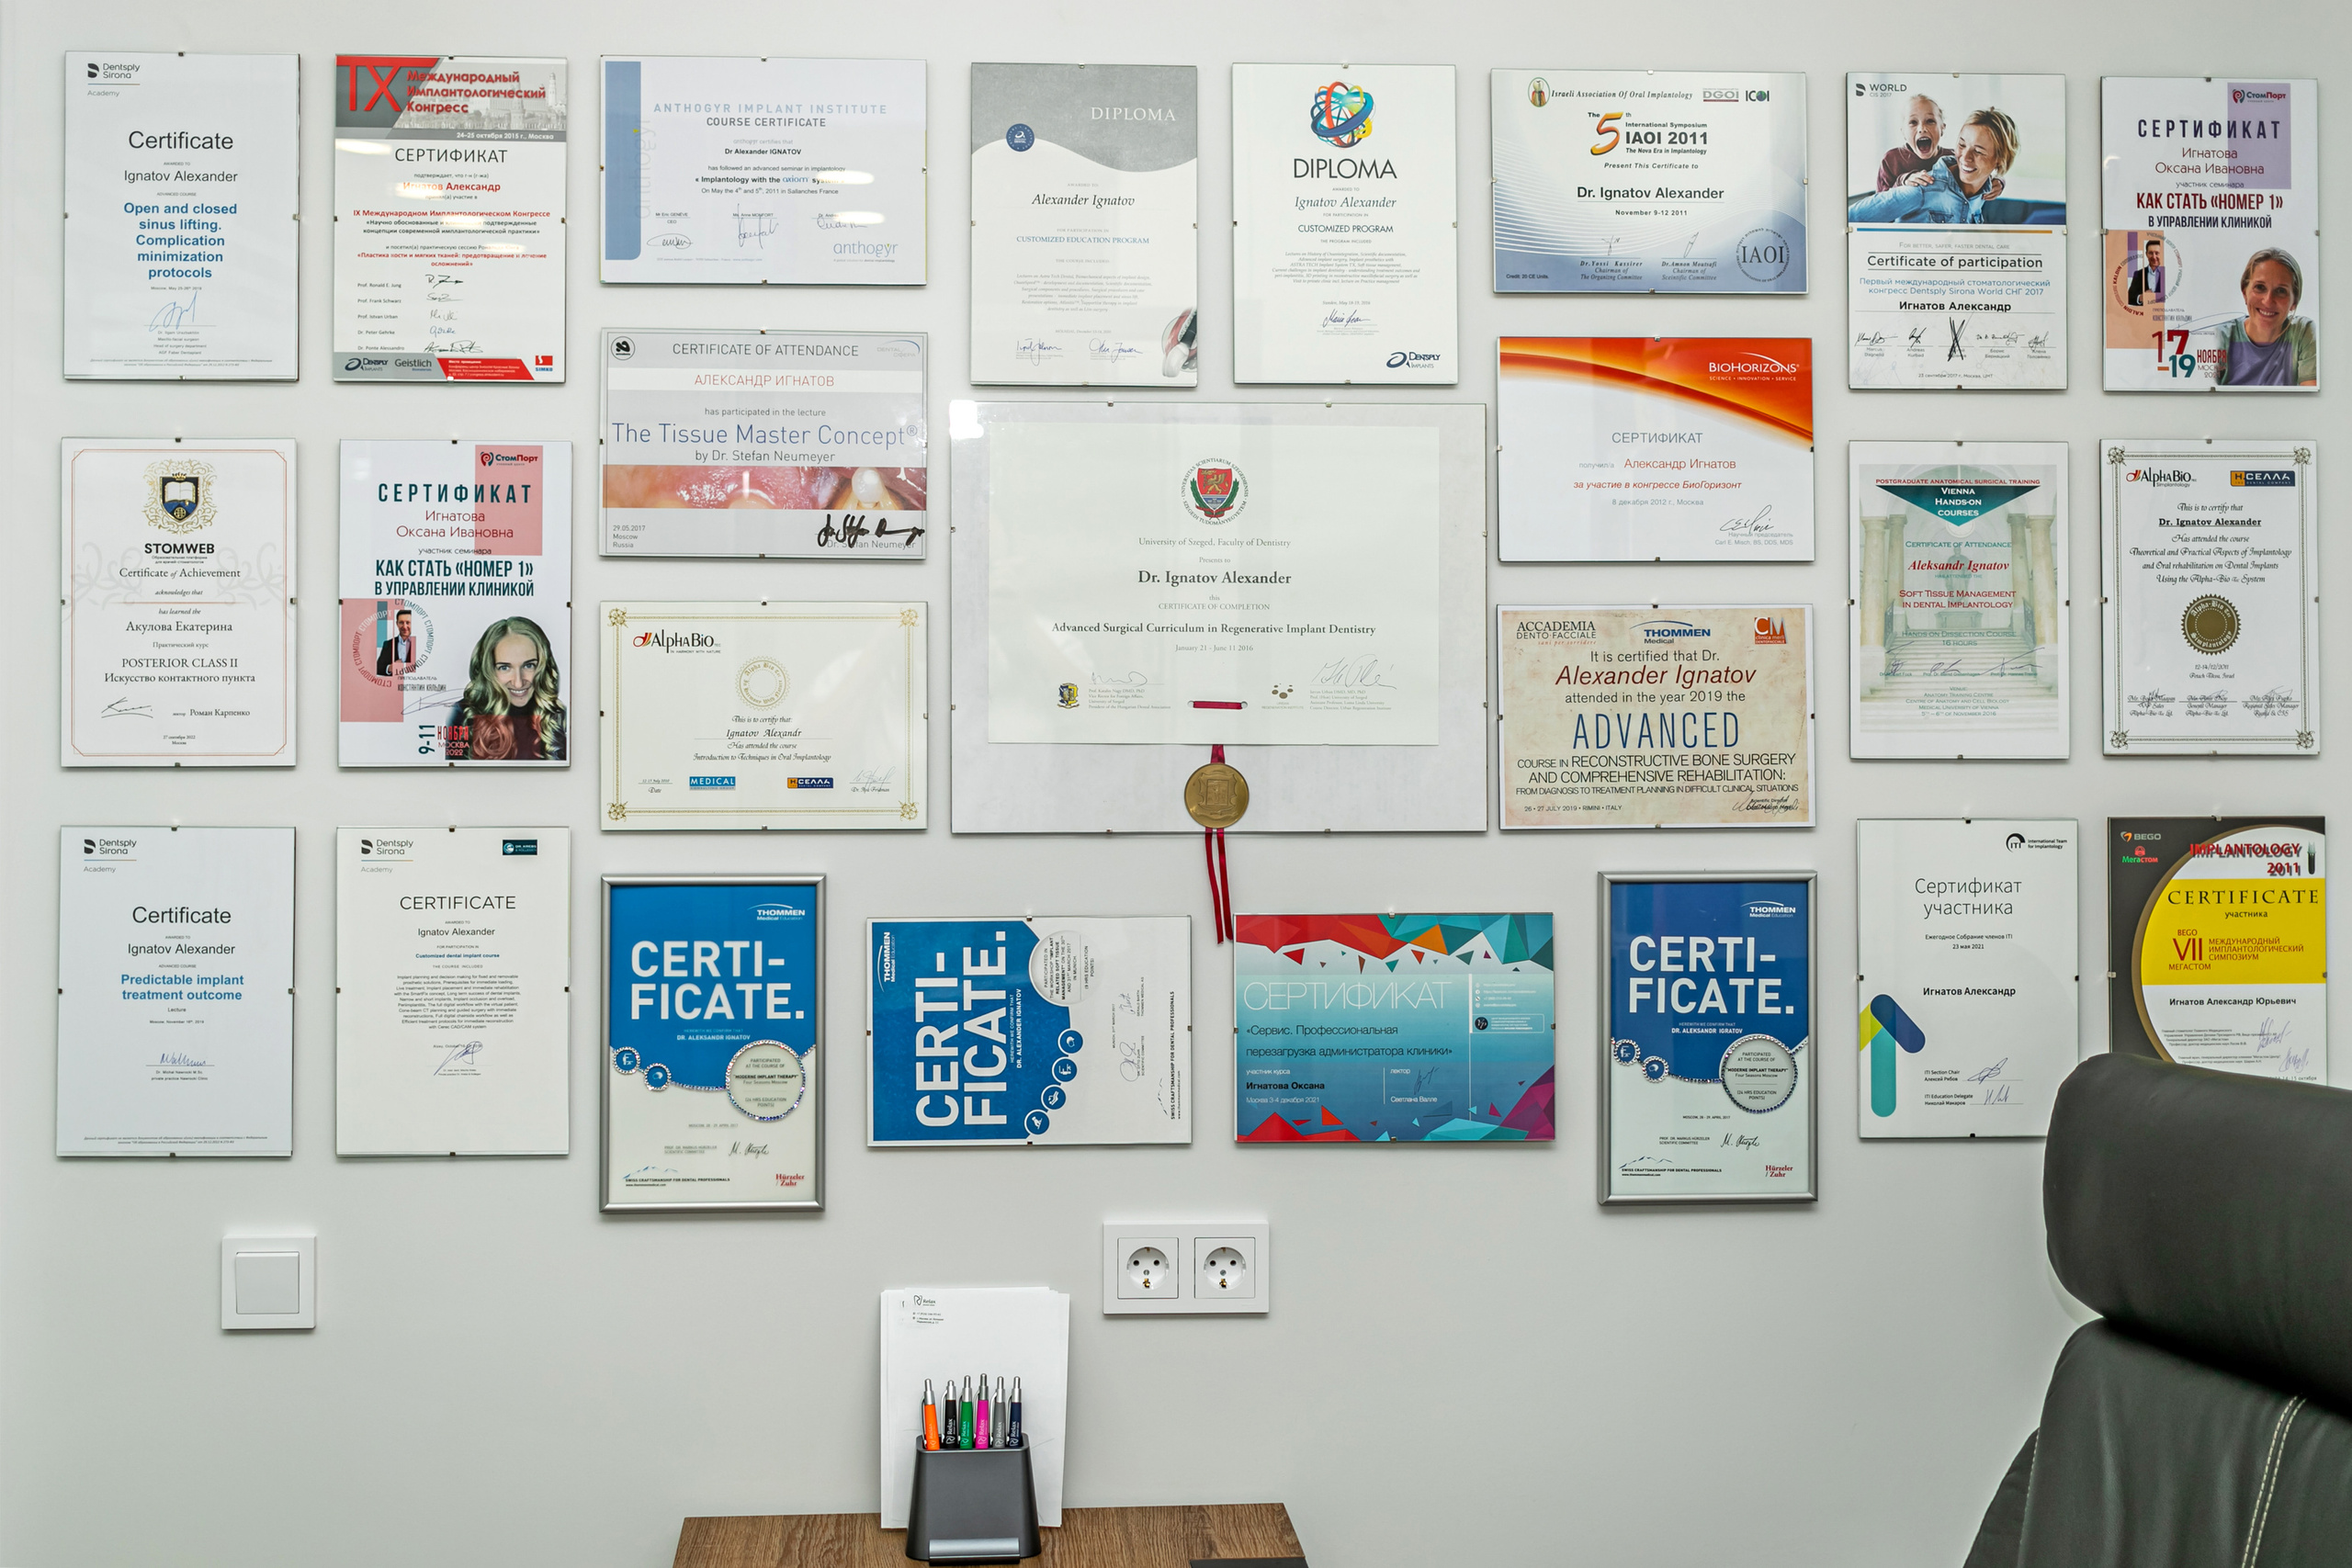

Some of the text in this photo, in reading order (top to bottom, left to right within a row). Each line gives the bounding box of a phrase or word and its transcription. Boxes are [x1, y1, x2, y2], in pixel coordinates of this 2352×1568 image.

[103, 63, 141, 73] Dentsply
[406, 70, 520, 84] Международный
[406, 86, 547, 99] Имплантологический
[1869, 84, 1907, 92] WORLD
[406, 101, 469, 115] Конгресс
[654, 103, 886, 114] ANTHOGYR IMPLANT INSTITUTE
[1091, 107, 1176, 121] DIPLOMA
[707, 118, 825, 127] COURSE CERTIFICATE
[129, 130, 233, 149] Certificate
[1626, 131, 1707, 144] IAOI 2011
[395, 149, 507, 163] СЕРТИФИКАТ
[1294, 158, 1396, 178] DIPLOMA
[125, 171, 238, 184] Ignatov Alexander
[447, 183, 500, 192] Александр
[124, 202, 237, 216] Open and closed
[140, 219, 220, 232] sinus lifting.
[2149, 215, 2271, 228] В УПРАВЛЕНИИ КЛИНИКОЙ
[136, 235, 224, 248] Complication
[832, 241, 899, 257] anthogyr
[138, 251, 222, 261] minimization
[1868, 254, 2042, 269] Certificate of participation
[149, 267, 211, 279] protocols
[1900, 301, 2011, 312] Игнатов Александр
[673, 344, 858, 356] CERTIFICATE OF ATTENDANCE
[2197, 349, 2227, 363] НОЯБРЯ
[395, 359, 433, 368] Geistlich
[695, 375, 834, 388] АЛЕКСАНДР ИГНАТОВ
[612, 423, 810, 444] The Tissue Master
[1612, 433, 1703, 443] СЕРТИФИКАТ
[1624, 458, 1736, 470] Александр Игнатов
[1682, 480, 1742, 491] БиоГоризонт
[379, 483, 531, 503] СЕРТИФИКАТ
[425, 511, 485, 523] Игнатова
[396, 526, 446, 538] Оксана
[450, 526, 514, 538] Ивановна
[145, 544, 214, 553] STOMWEB
[377, 560, 533, 577] КАК СТАТЬ «НОМЕР 1»
[1908, 560, 2009, 572] Aleksandr Ignatov
[119, 568, 241, 579] Certificate of Achievement
[1138, 570, 1291, 586] Dr. Ignatov Alexander
[126, 621, 232, 634] Акулова Екатерина
[1053, 623, 1100, 632] Advanced
[1103, 623, 1143, 635] Surgical
[1147, 623, 1204, 632] Curriculum
[1222, 624, 1283, 636] Regenerative
[1287, 625, 1325, 636] Implant
[1329, 625, 1375, 636] Dentistry
[1645, 629, 1711, 637] THOMMEN
[123, 659, 237, 667] POSTERIOR CLASS II
[1566, 691, 1746, 705] attended in the year 2019 the
[215, 709, 250, 718] Карпенко
[727, 728, 801, 739] Ignatov Alexandr
[1572, 712, 1739, 750] ADVANCED
[2189, 843, 2302, 858] IMPLANTOLOGY
[2267, 863, 2301, 876] 2011
[1916, 877, 2021, 897] Сертификат
[401, 897, 515, 909] CERTIFICATE
[2167, 890, 2319, 905] CERTIFICATE
[132, 907, 231, 923] Certificate
[1924, 903, 2012, 919] участника
[632, 941, 785, 977] CERTI-
[121, 975, 243, 987] Predictable implant
[122, 990, 242, 999] treatment outcome
[1244, 982, 1452, 1010] СЕРТИФИКАТ
[1924, 987, 2016, 997] Игнатов Александр
[631, 983, 804, 1020] FICATE.
[2256, 998, 2296, 1006] Юрьевич
[964, 931, 1007, 1125] FICATE.
[915, 952, 959, 1127] CERTI-
[1247, 1047, 1452, 1058] перезагрузка администратора клиники»
[1247, 1081, 1326, 1090] Игнатова Оксана
